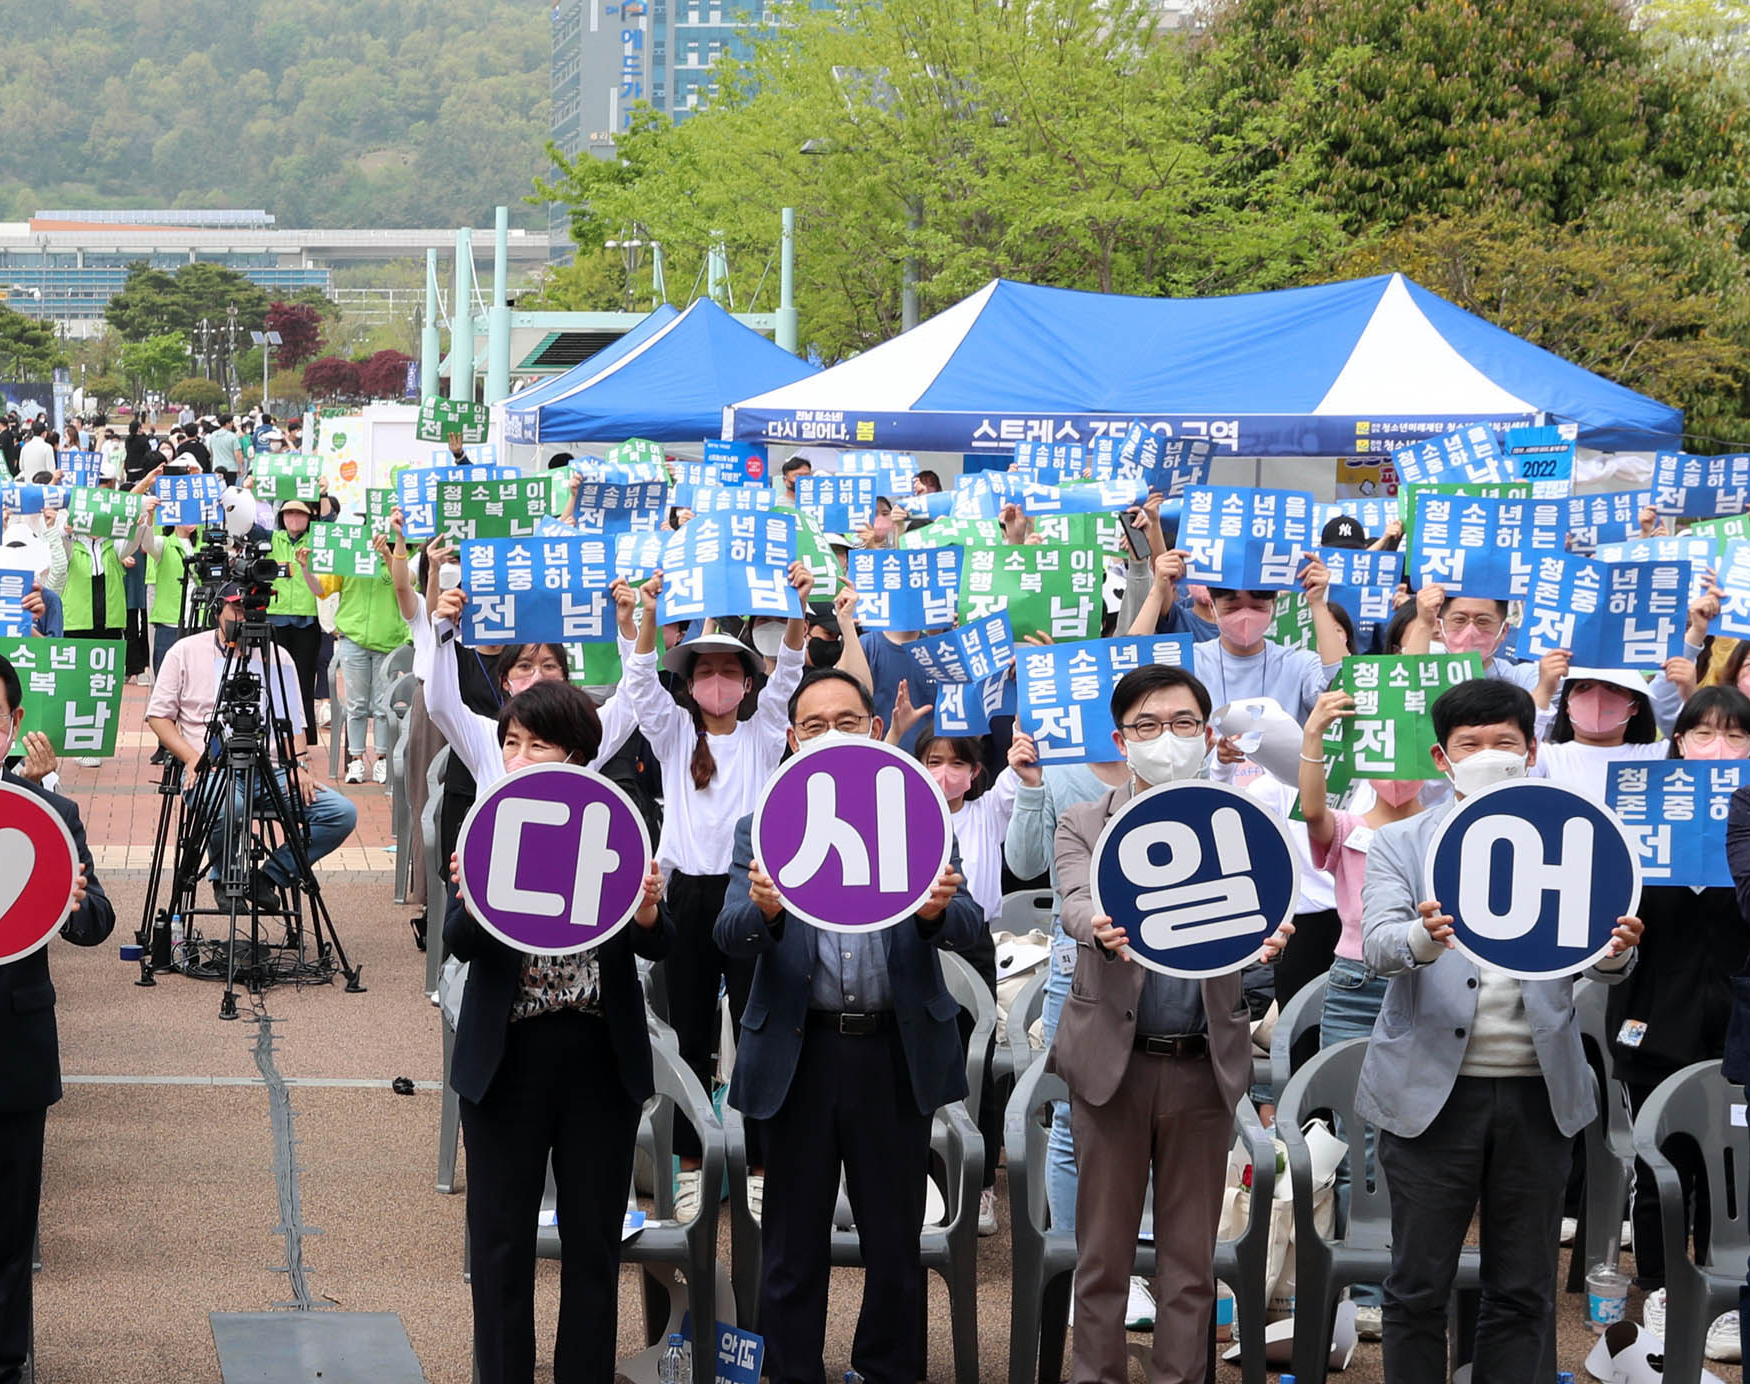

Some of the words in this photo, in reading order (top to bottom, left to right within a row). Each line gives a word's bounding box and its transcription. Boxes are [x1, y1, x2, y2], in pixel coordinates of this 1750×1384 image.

[421, 420, 486, 442] 전남
[768, 421, 797, 438] 다시
[802, 422, 850, 440] 일어나,
[971, 419, 1081, 448] 스트레스
[1019, 444, 1082, 458] 청소년을
[1522, 460, 1557, 478] 2022
[1660, 456, 1750, 474] 청소년을
[256, 476, 317, 498] 전남
[582, 484, 662, 497] 청소년을
[800, 479, 872, 492] 청소년을
[1658, 470, 1749, 487] 존중하는
[443, 483, 545, 501] 청소년이
[800, 491, 872, 504] 존중하는
[1190, 491, 1307, 517] 청소년을
[1655, 486, 1748, 515] 전남
[160, 500, 223, 523] 전남
[443, 500, 547, 517] 행복한
[579, 507, 659, 533] 전남
[801, 505, 873, 530] 전남
[1424, 500, 1559, 527] 청소년을
[73, 511, 134, 540] 전남
[665, 516, 788, 549] 청소년을
[1186, 515, 1306, 539] 존중하는
[1423, 523, 1557, 549] 존중하는
[312, 550, 377, 575] 전남
[469, 542, 606, 568] 청소년을
[663, 540, 788, 568] 존중하는
[855, 551, 956, 574] 청소년을
[971, 550, 1094, 572] 청소년이
[1185, 539, 1304, 586] 전남
[471, 568, 607, 592] 존중하는
[855, 569, 957, 590] 존중하는
[969, 573, 1096, 593] 행복한
[1539, 557, 1680, 590] 청소년을
[664, 567, 790, 616] 전남
[1535, 582, 1678, 614] 존중하는
[471, 592, 607, 639] 전남
[856, 589, 958, 627] 전남
[1529, 608, 1676, 664] 전남
[1026, 641, 1183, 678] 청소년을
[1353, 661, 1472, 688] 청소년이
[778, 766, 910, 894] 시
[486, 797, 621, 926] 다
[1117, 807, 1268, 950] 일
[1459, 813, 1594, 948] 어
